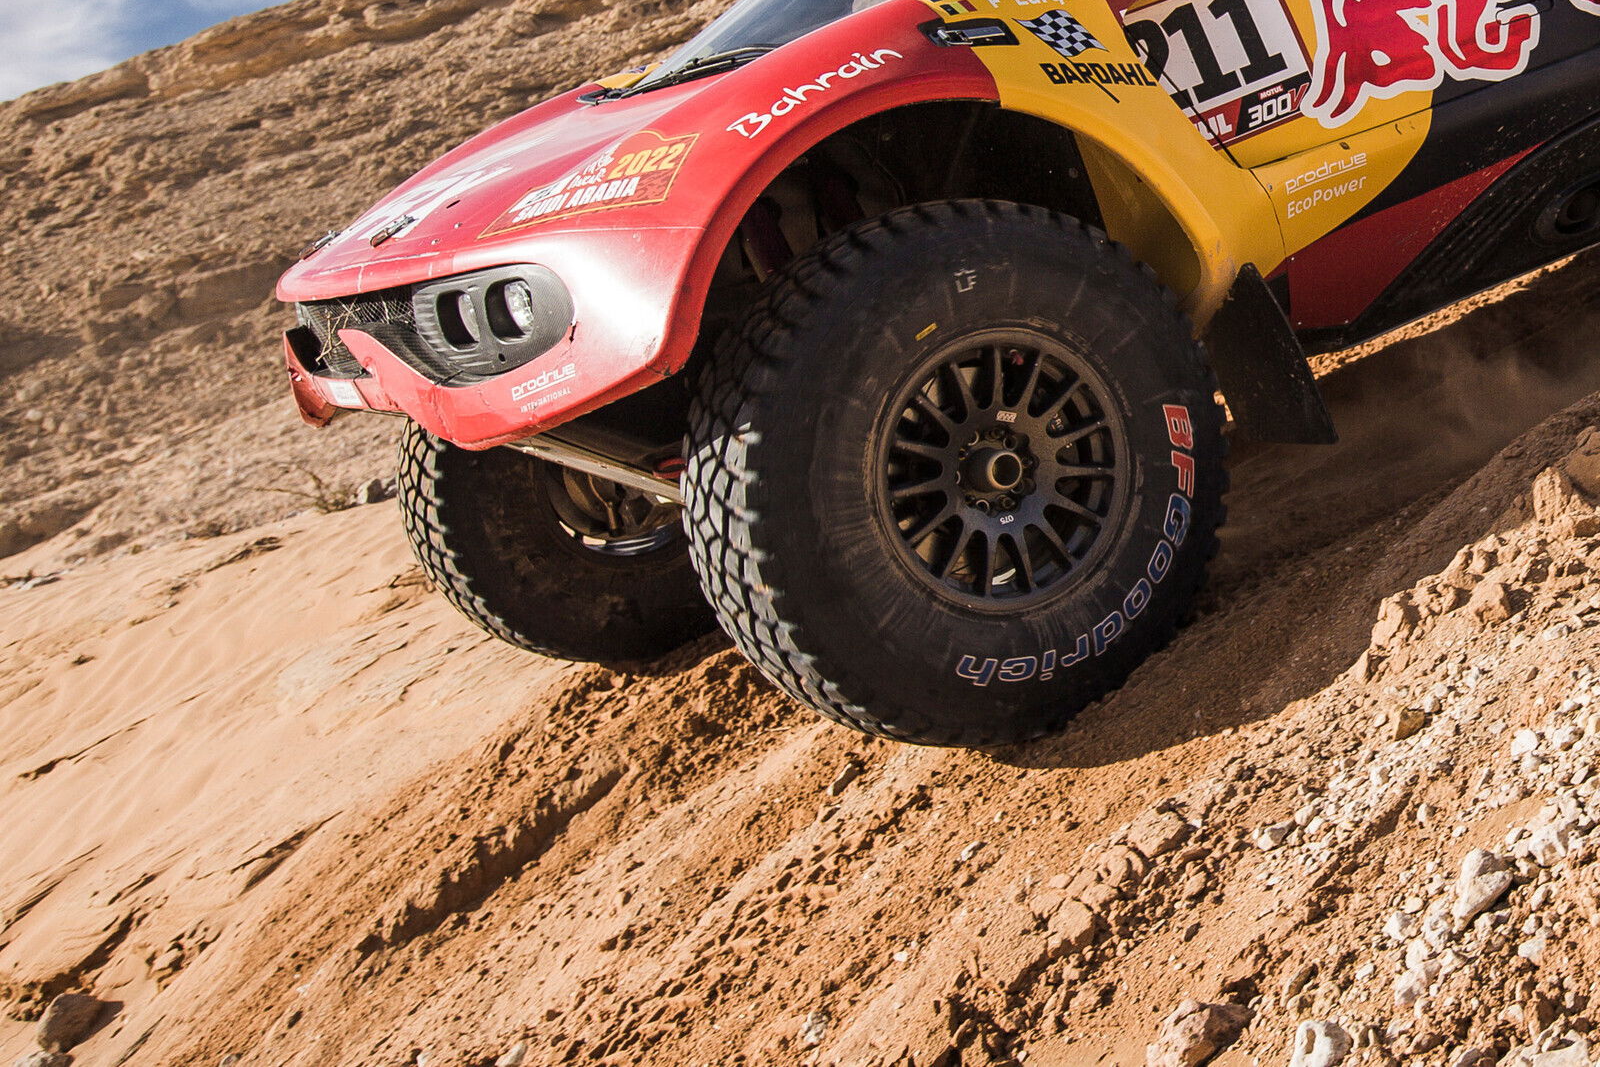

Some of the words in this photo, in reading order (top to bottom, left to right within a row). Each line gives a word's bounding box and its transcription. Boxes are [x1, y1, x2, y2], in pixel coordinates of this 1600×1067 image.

[726, 48, 904, 139] Bahrain
[1039, 62, 1158, 87] BARDAHL
[1260, 86, 1284, 100] MOTUL
[606, 143, 687, 181] 2022
[512, 192, 571, 223] SAUDI
[565, 177, 641, 209] ARABIA
[1287, 176, 1367, 220] EcoPower
[955, 403, 1195, 687] BFGoodrich
